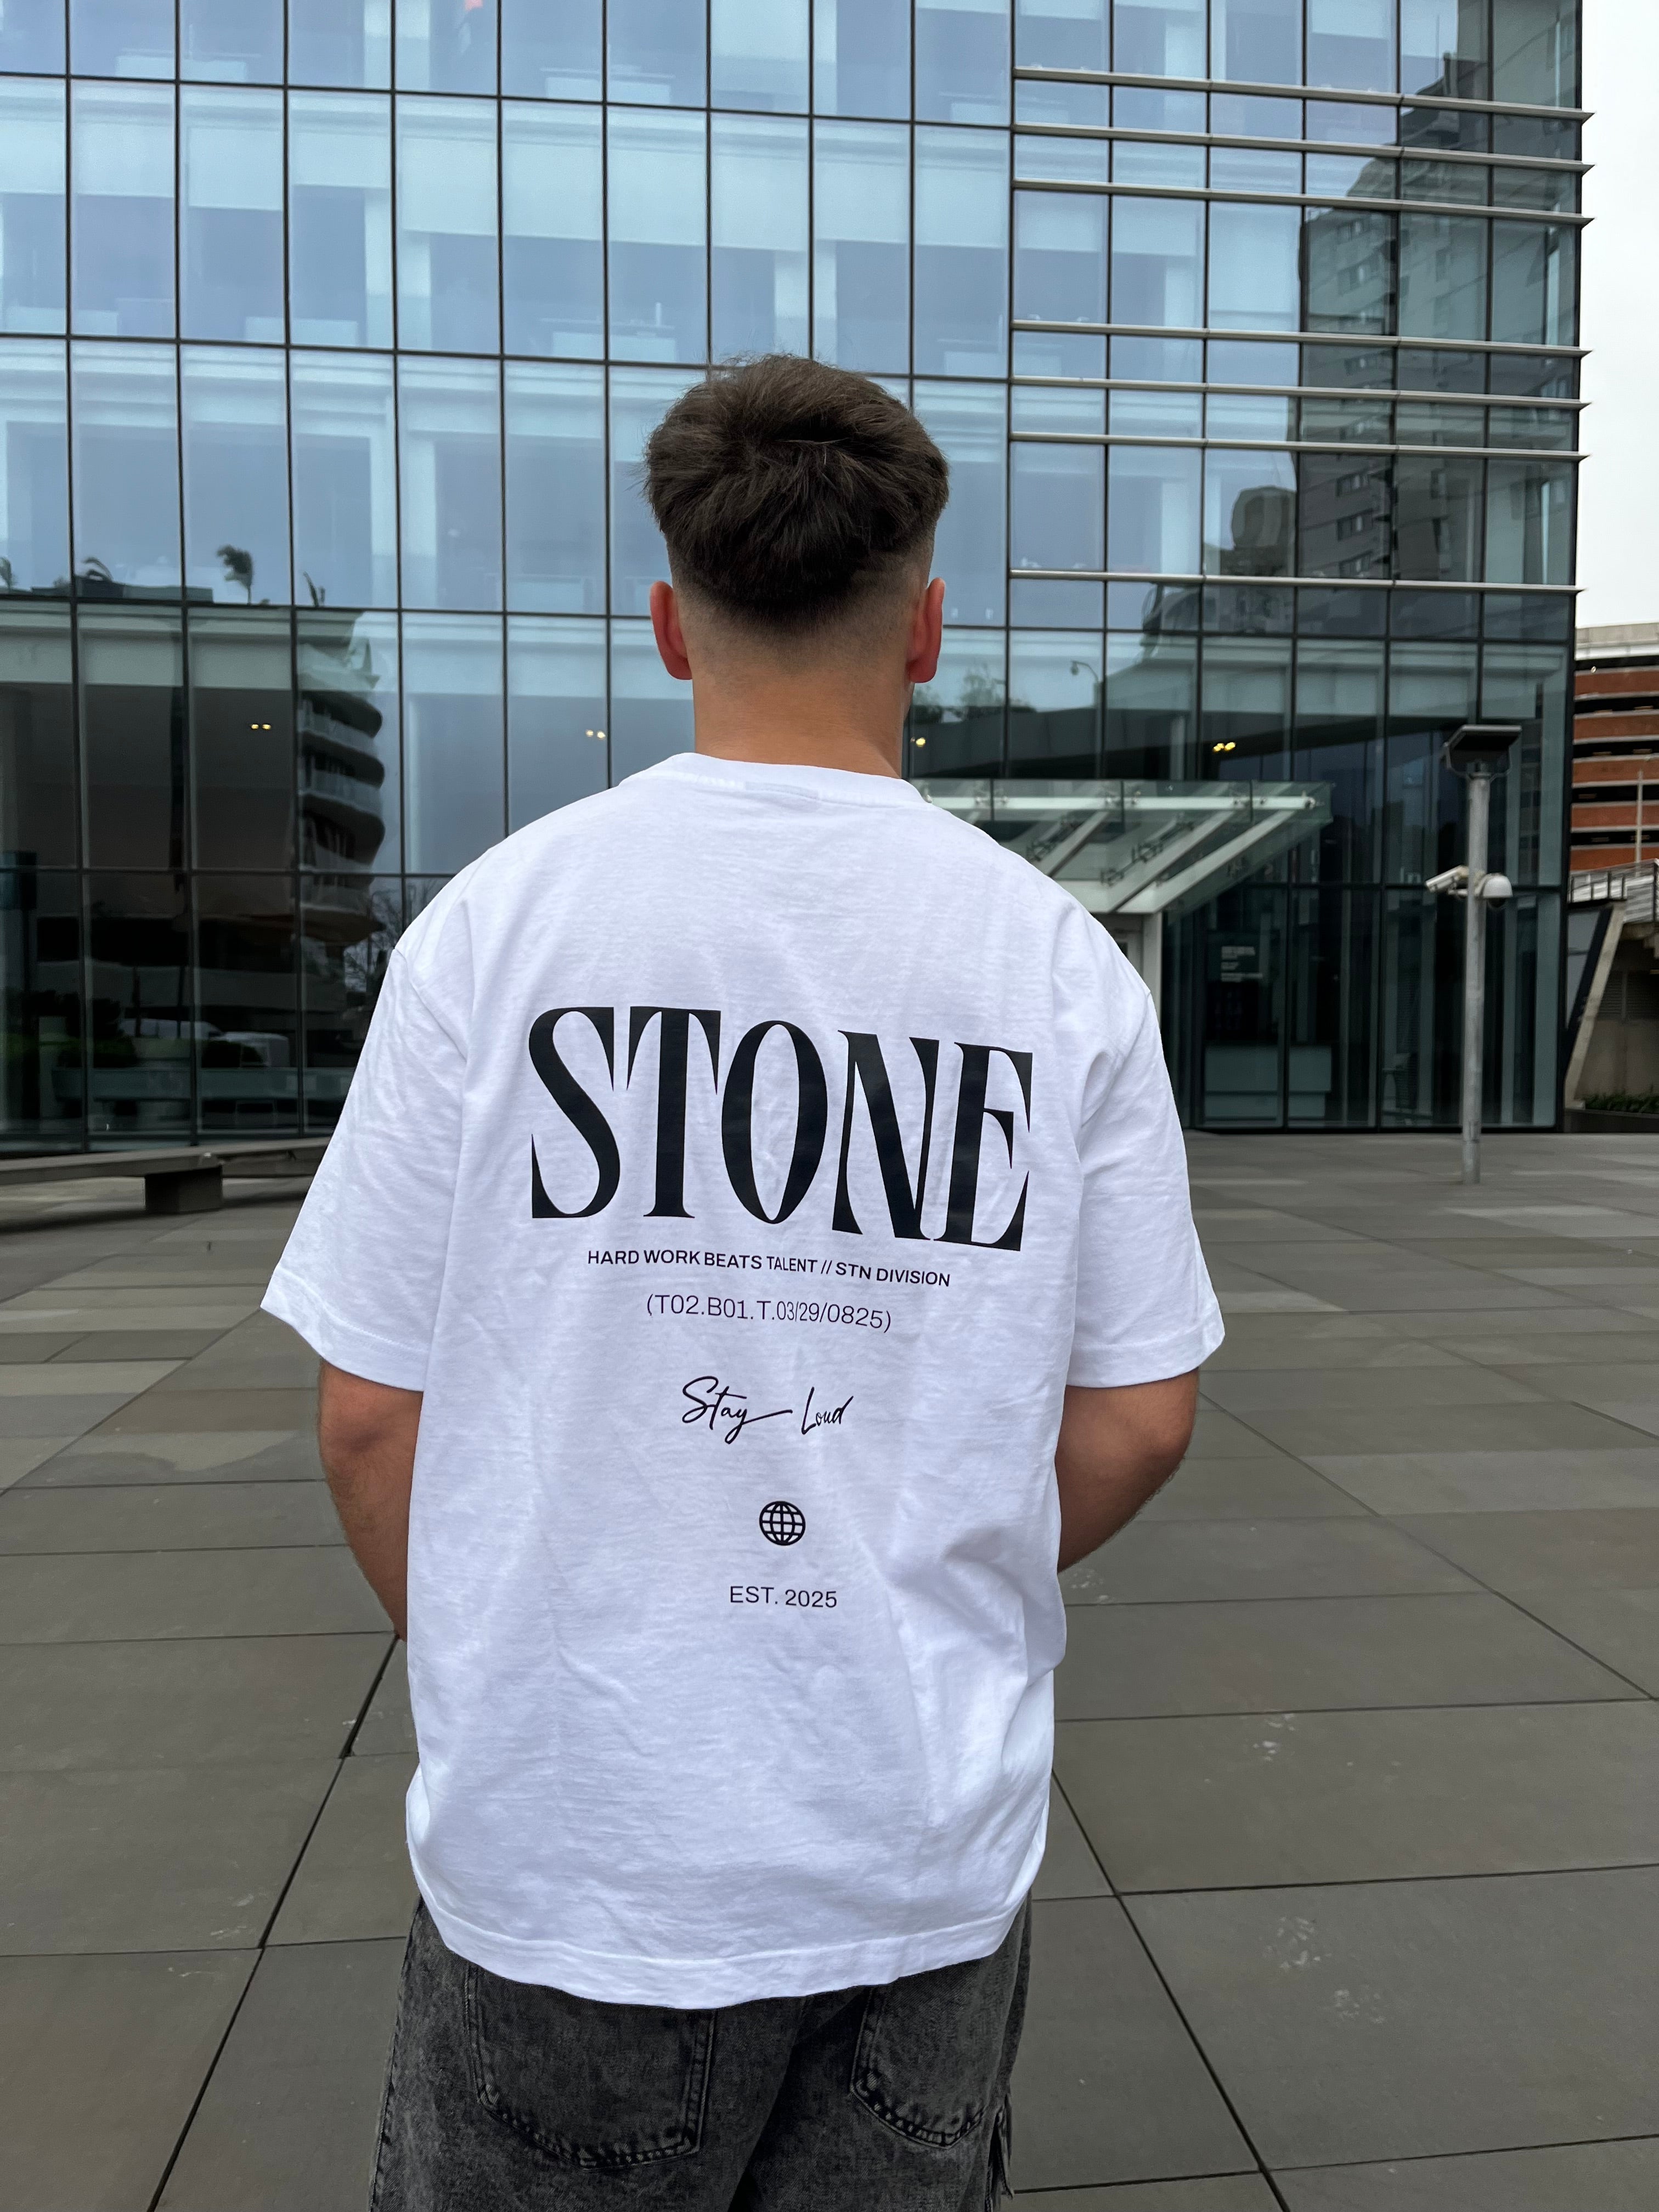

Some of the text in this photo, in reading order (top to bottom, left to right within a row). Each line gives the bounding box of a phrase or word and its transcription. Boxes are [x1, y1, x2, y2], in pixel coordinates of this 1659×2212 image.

[528, 1006, 1034, 1252] STONE
[587, 1249, 951, 1288] HARD WORK BEATS TALENT // STN DIVISION
[646, 1293, 891, 1334] (T02.B01.T.03/29/0825)
[681, 1375, 855, 1445] Stay Loud
[730, 1585, 838, 1609] EST. 2025
